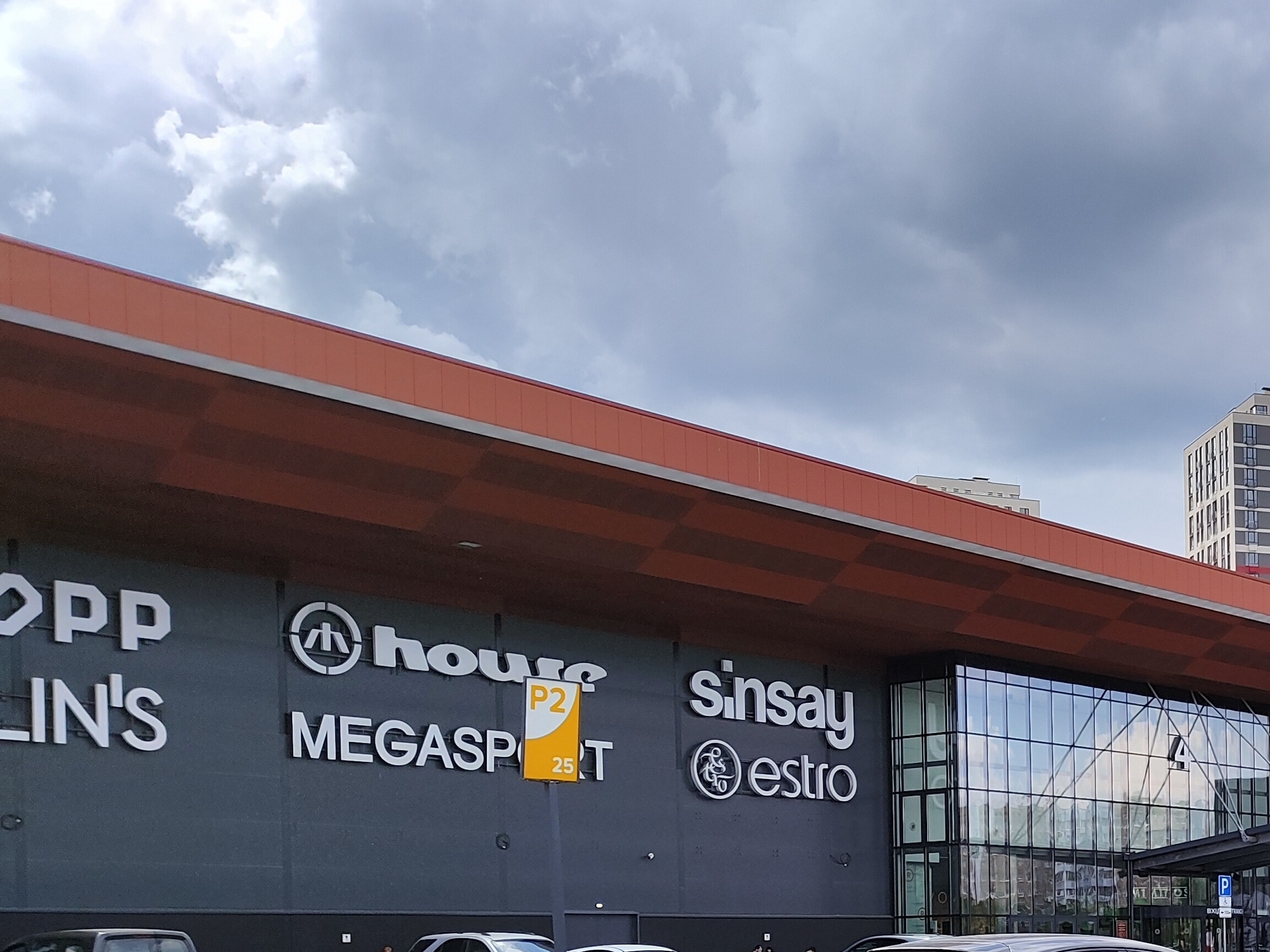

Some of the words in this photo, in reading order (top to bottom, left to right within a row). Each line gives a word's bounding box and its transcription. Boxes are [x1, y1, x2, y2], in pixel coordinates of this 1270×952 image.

[530, 684, 566, 713] P2
[689, 659, 855, 750] sinsay
[291, 711, 614, 781] MEGASPT
[1170, 736, 1194, 771] 4
[552, 757, 574, 774] 25
[747, 754, 858, 802] estro
[1221, 878, 1229, 894] P
